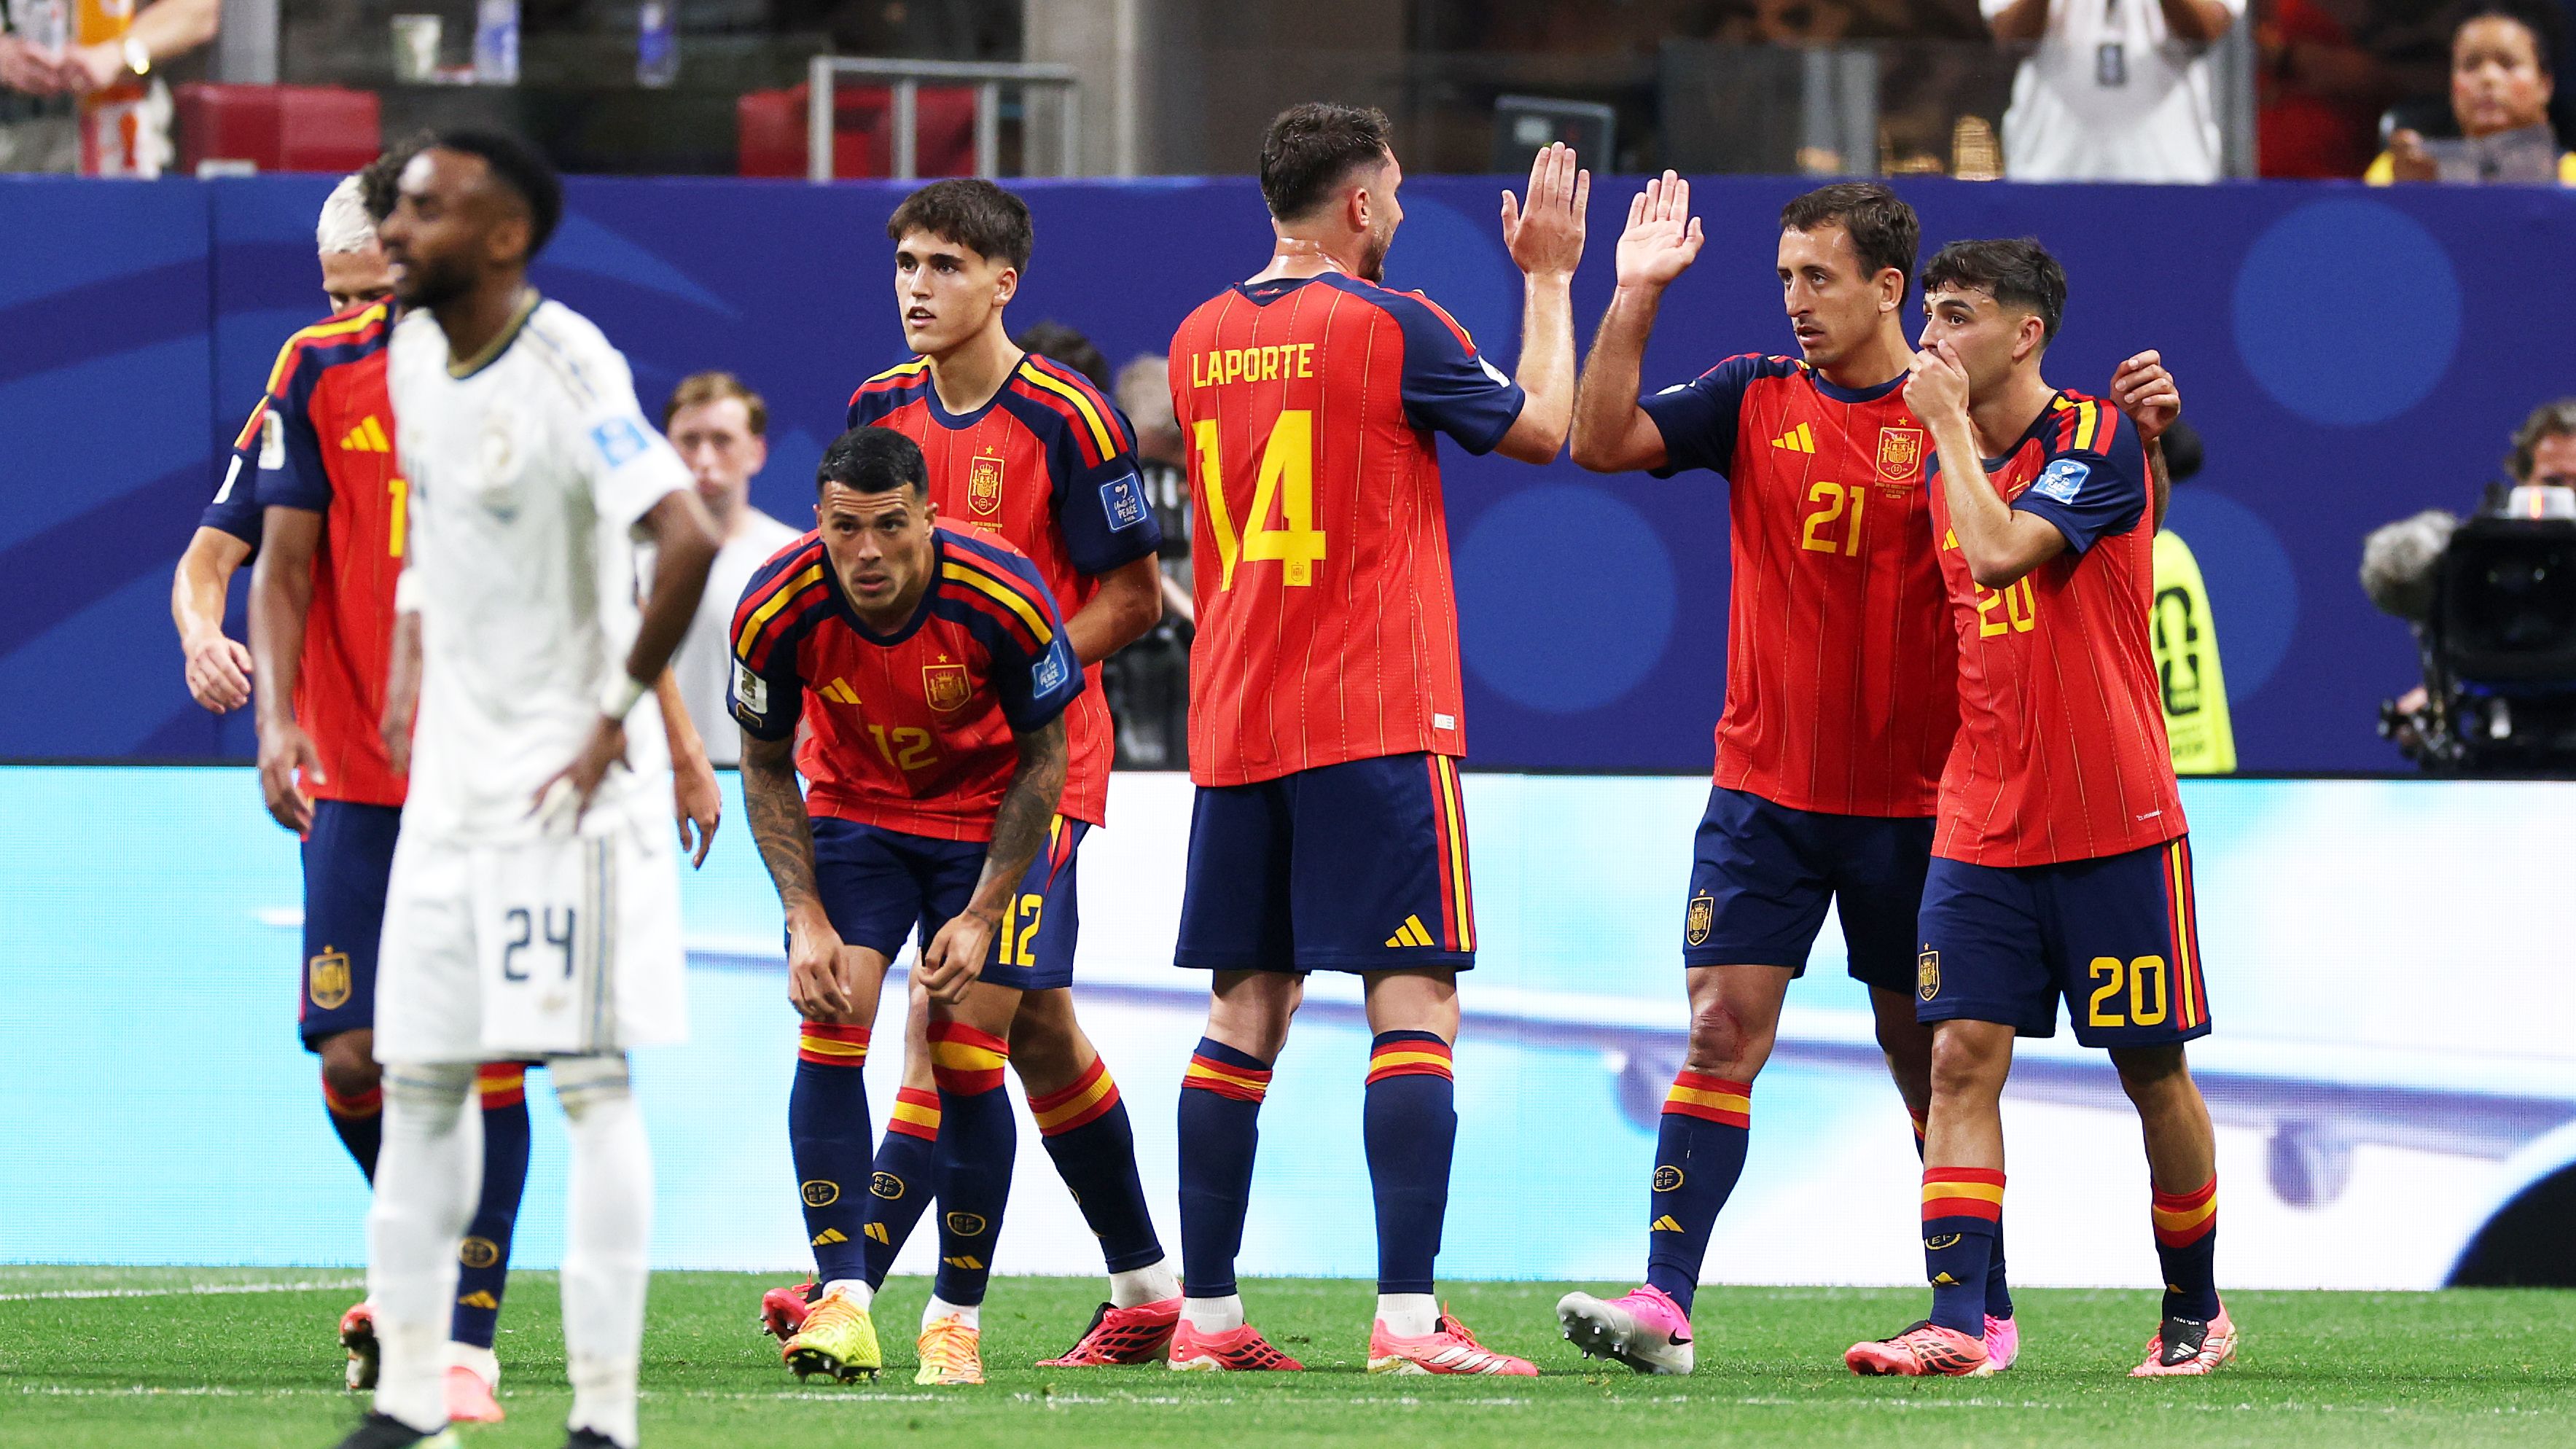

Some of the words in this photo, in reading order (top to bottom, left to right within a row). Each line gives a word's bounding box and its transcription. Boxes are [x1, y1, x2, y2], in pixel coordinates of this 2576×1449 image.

[1193, 343, 1315, 388] LAPORTE
[1117, 504, 1137, 519] PEACE
[1191, 410, 1327, 593] 14
[1801, 481, 1865, 557] 21
[1973, 574, 2035, 638] 20
[868, 724, 938, 770] 12
[504, 907, 575, 982] 24
[998, 893, 1043, 967] 12
[2089, 955, 2166, 1027] 20
